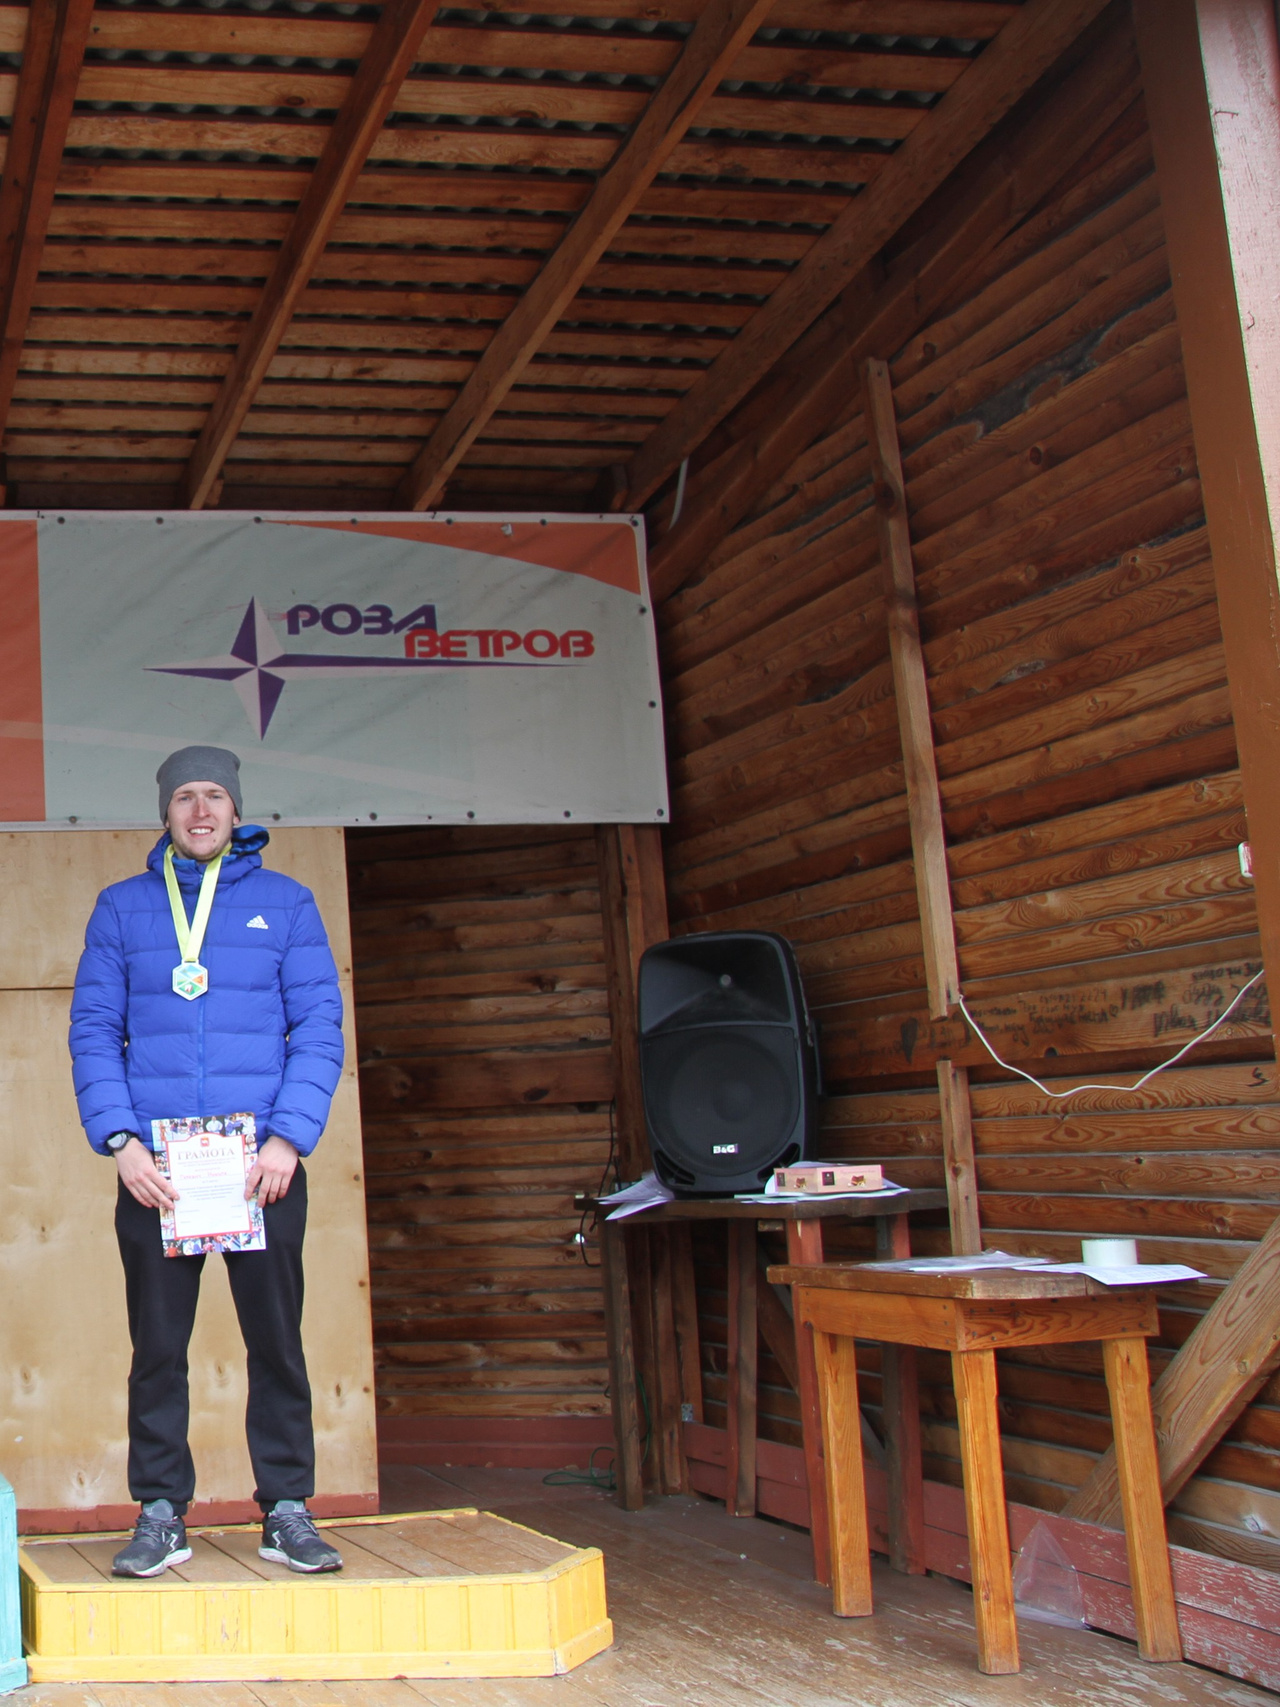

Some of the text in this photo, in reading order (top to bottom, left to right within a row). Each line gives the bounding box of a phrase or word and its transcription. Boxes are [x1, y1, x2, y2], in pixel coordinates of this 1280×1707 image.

[286, 603, 438, 635] РОЗА
[404, 628, 596, 659] ВЕТРОВ
[178, 1148, 235, 1160] ГРАМОТА
